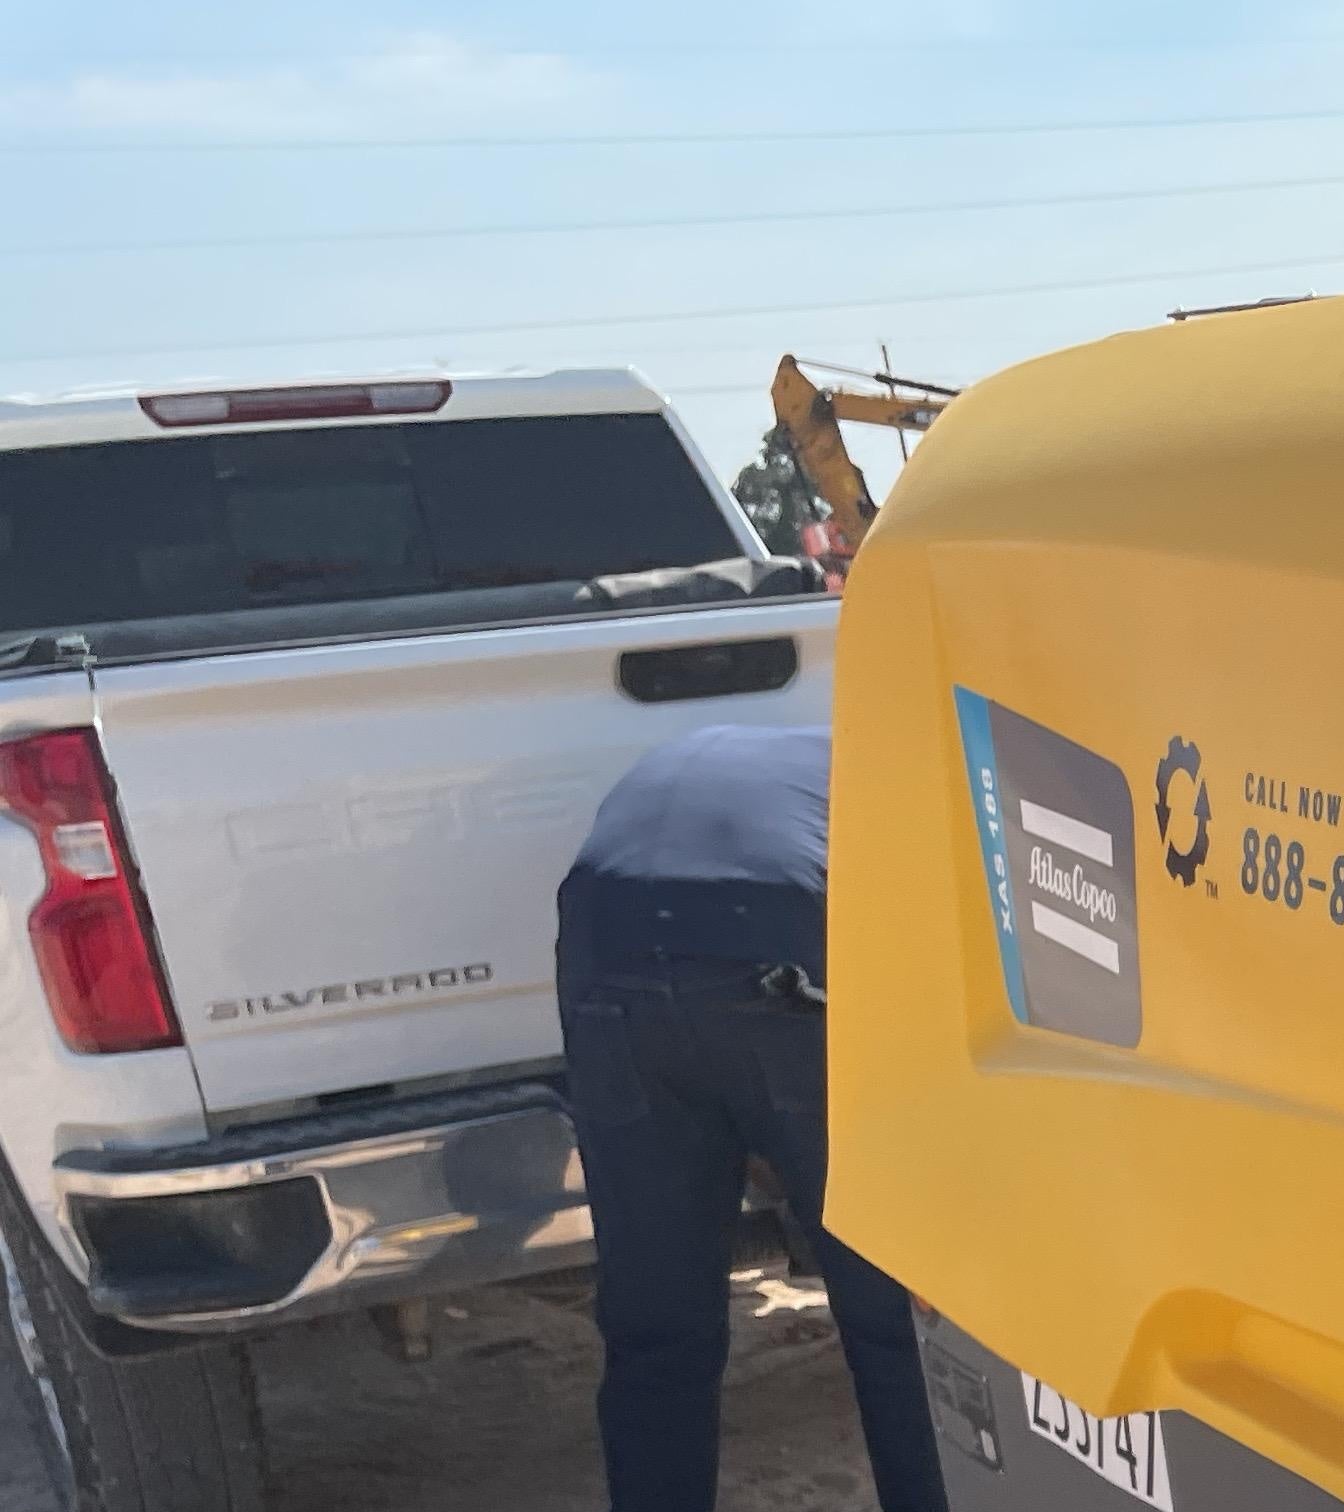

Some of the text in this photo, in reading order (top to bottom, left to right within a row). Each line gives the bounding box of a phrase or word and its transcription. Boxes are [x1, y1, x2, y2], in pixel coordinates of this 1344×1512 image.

[1244, 772, 1342, 827] CALL NOW
[207, 962, 494, 1021] SILVERADO
